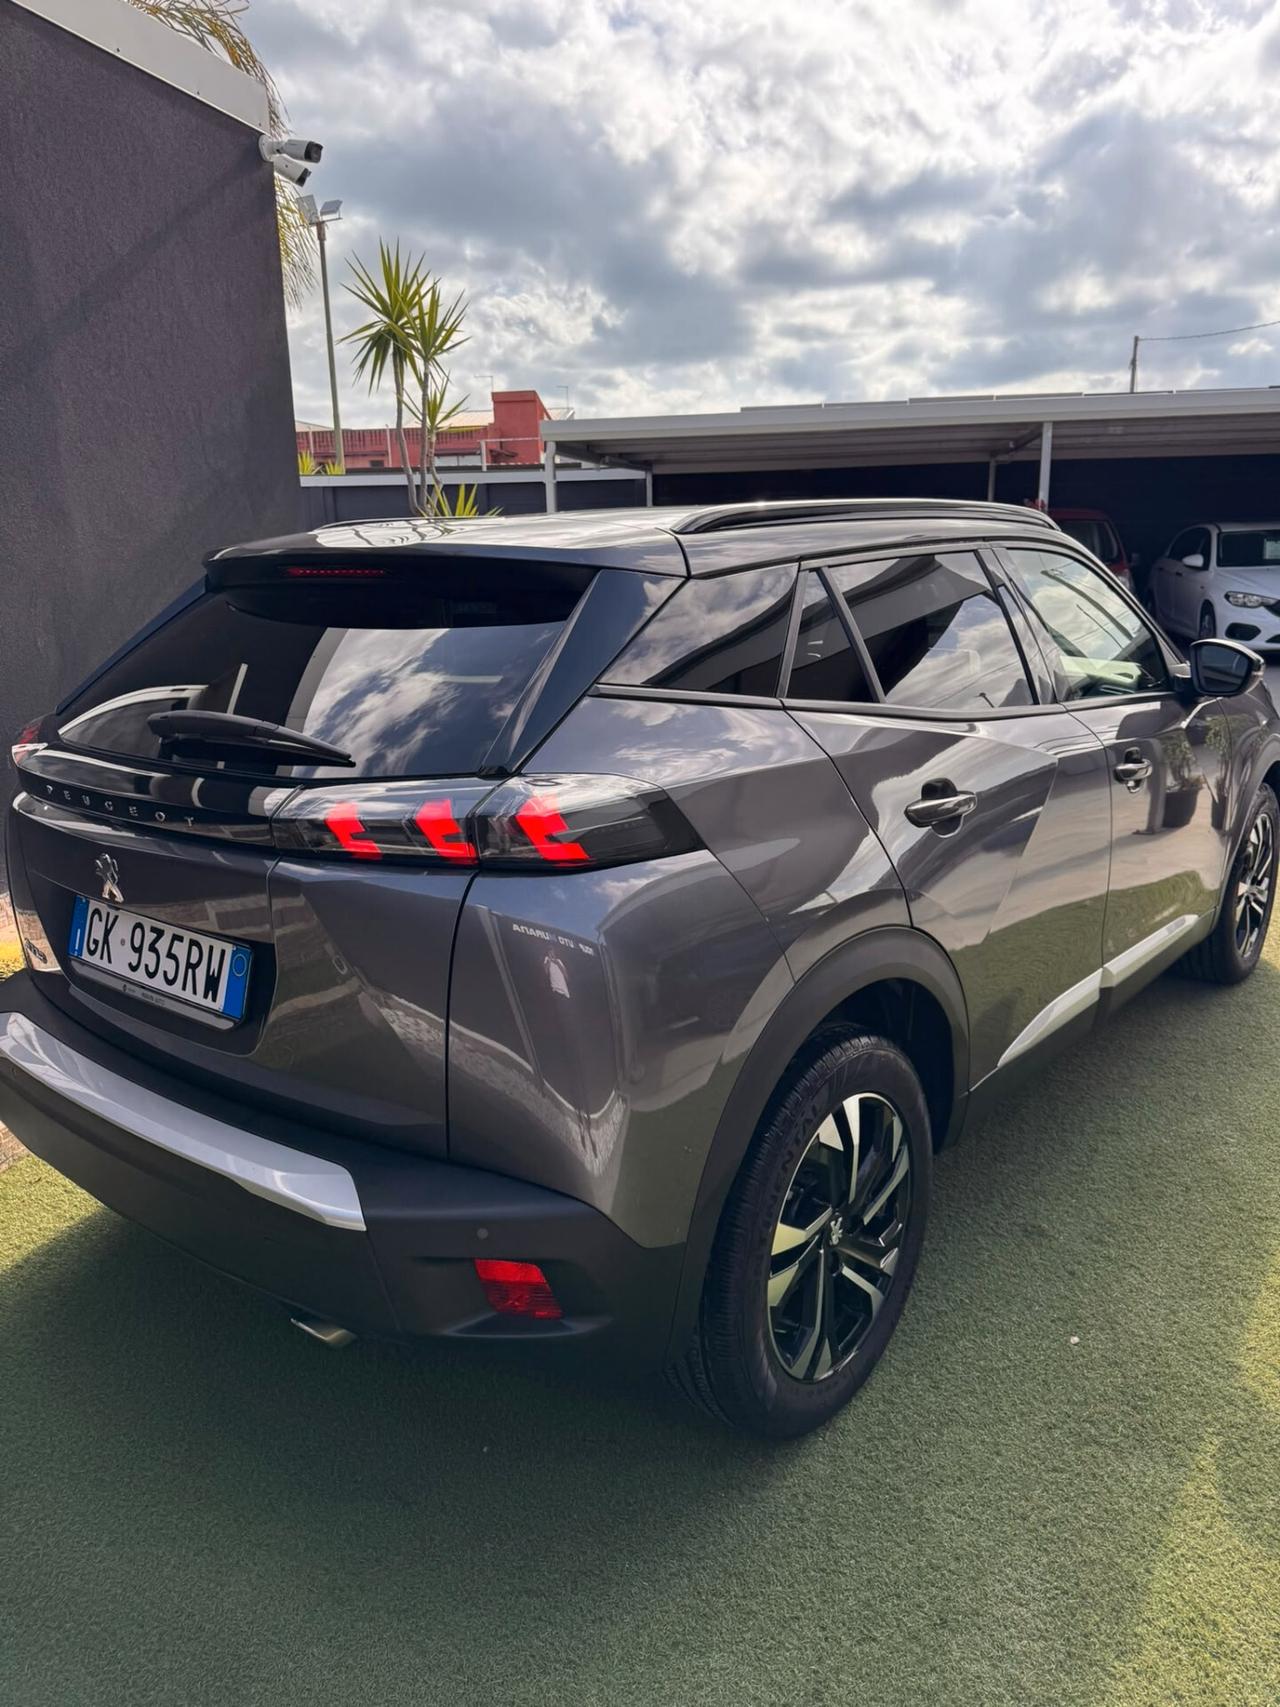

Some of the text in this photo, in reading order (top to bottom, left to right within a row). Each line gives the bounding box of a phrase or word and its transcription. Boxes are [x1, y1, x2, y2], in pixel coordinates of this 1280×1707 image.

[46, 784, 194, 827] PEUGEOT
[85, 907, 119, 965] GK
[127, 921, 225, 1004] 935RW
